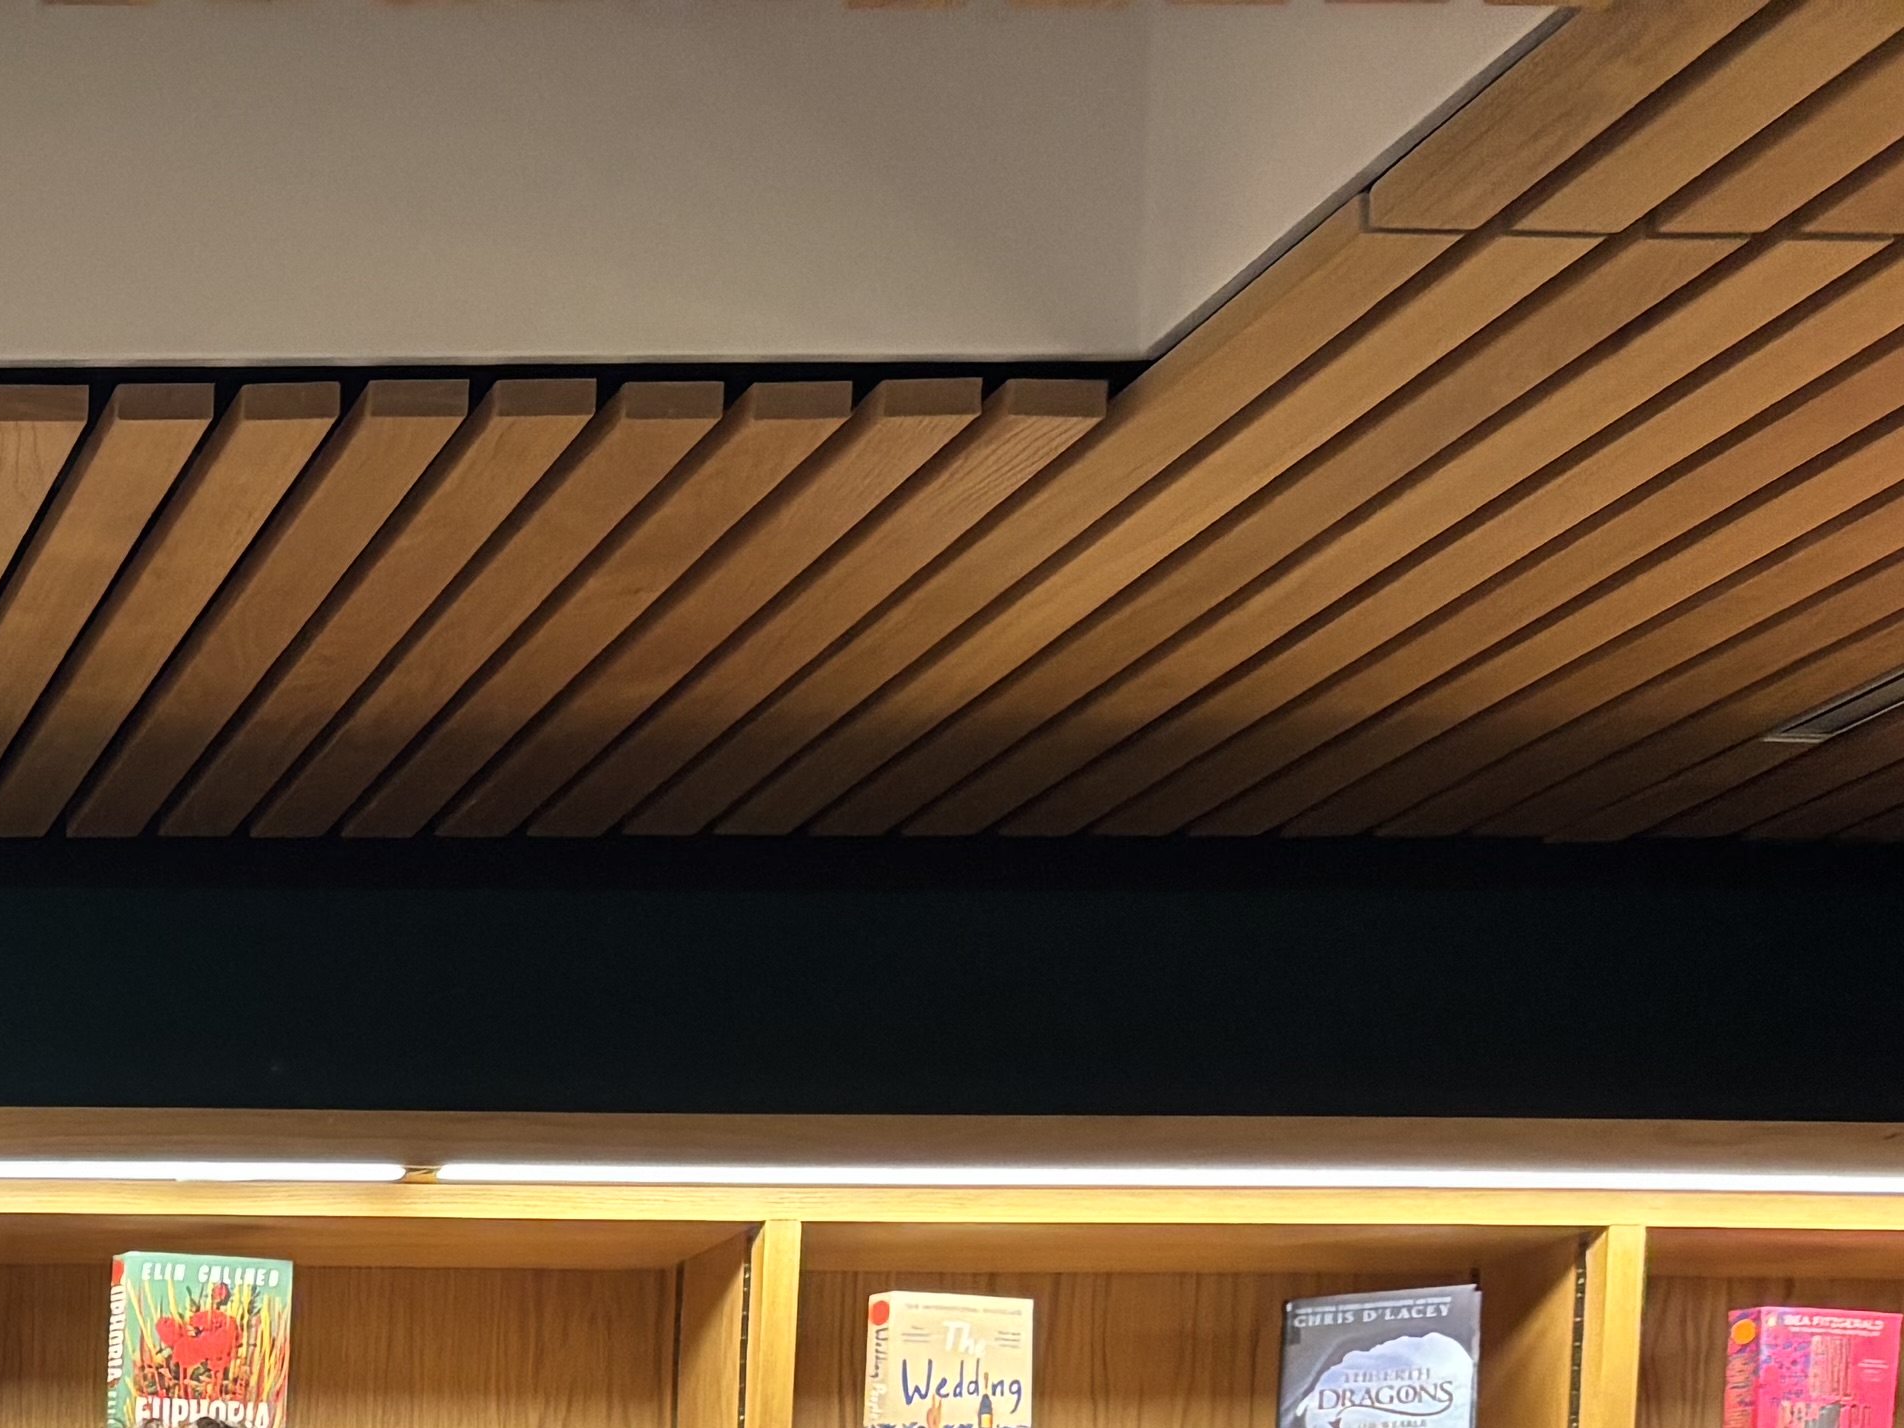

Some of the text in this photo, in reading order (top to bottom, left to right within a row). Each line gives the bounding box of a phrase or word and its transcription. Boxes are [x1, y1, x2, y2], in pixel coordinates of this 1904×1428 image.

[142, 1263, 186, 1281] ELIN
[1294, 1311, 1355, 1328] CHRIS
[1363, 1303, 1452, 1323] D'LACEY
[942, 1321, 987, 1358] The
[901, 1358, 1023, 1415] Wedding
[1318, 1380, 1453, 1410] DRAGONS
